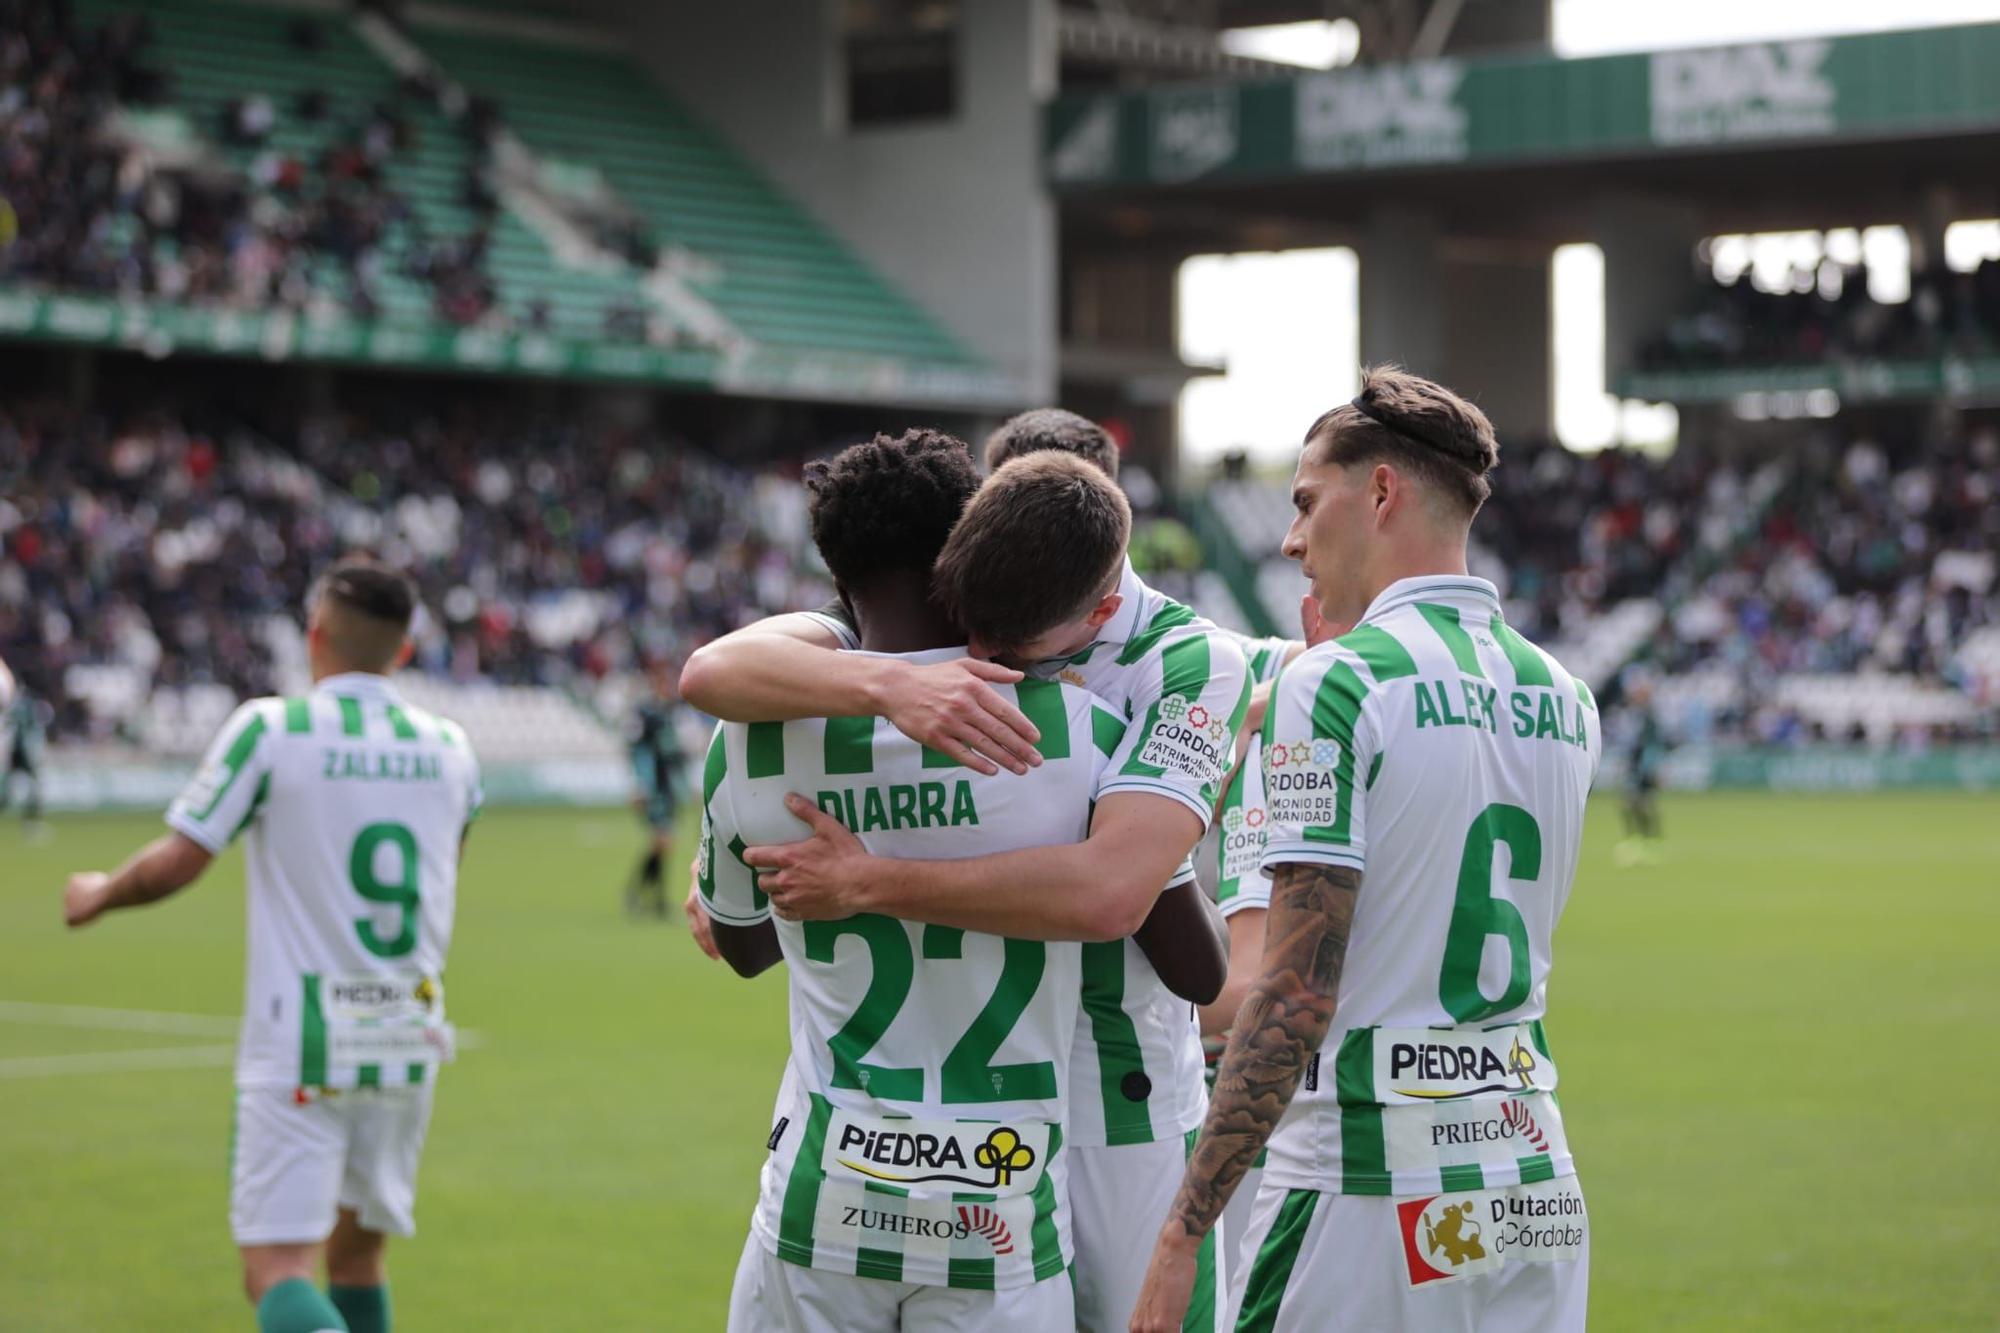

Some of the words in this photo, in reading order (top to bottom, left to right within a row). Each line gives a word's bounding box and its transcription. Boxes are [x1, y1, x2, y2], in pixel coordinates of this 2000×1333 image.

[1414, 679, 1497, 735] ALEX
[1511, 691, 1587, 751] SALA
[1143, 751, 1157, 763] LA
[817, 780, 979, 833] DIARRA
[1315, 797, 1332, 809] DE
[349, 822, 420, 959] 9
[1439, 802, 1542, 1025] 6
[802, 912, 1058, 1105] 22
[1432, 1119, 1515, 1146] PRIEGO
[842, 1206, 971, 1241] ZUHEROS
[1491, 1192, 1583, 1223] Dutación
